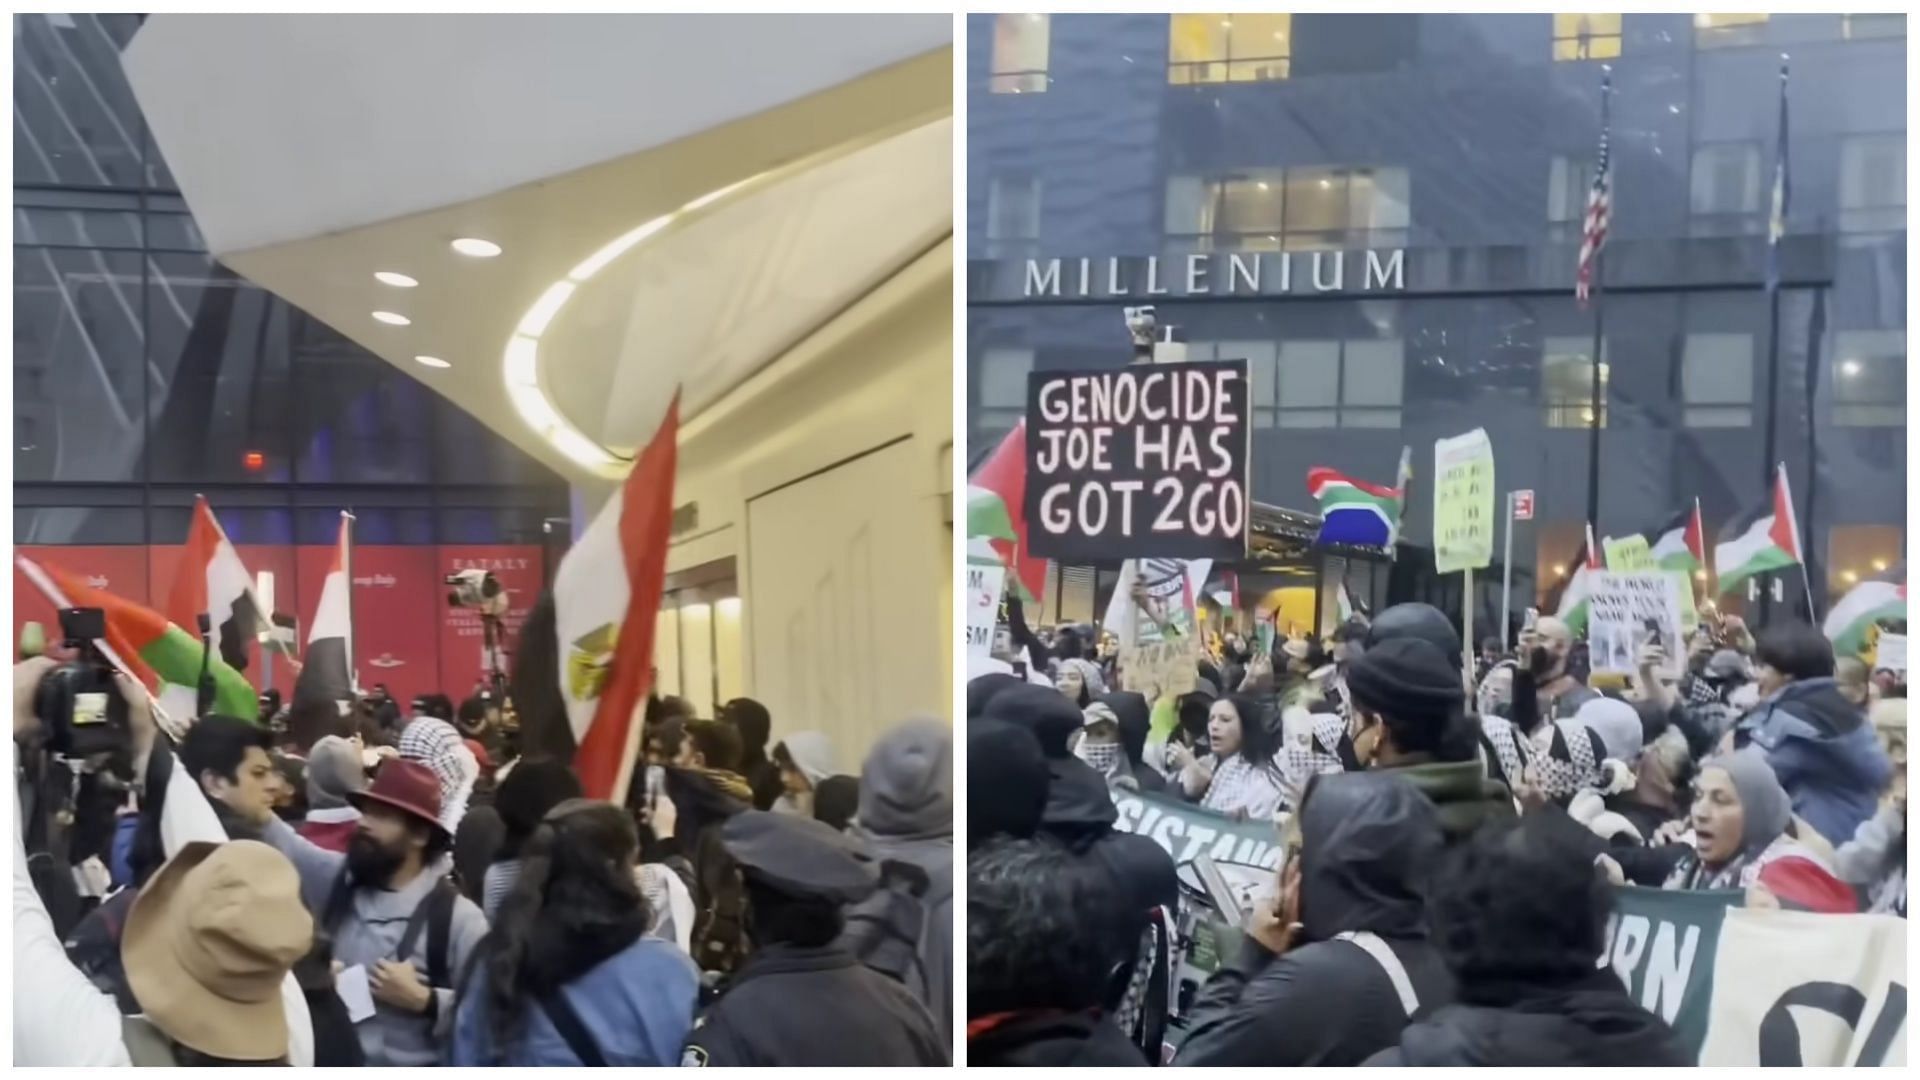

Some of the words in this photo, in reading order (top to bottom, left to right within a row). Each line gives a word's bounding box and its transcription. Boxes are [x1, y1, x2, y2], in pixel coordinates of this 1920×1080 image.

[1024, 250, 1404, 295] MILLENIUM
[1038, 370, 1239, 425] GENOCIDE
[1036, 429, 1113, 474] JOE
[1135, 424, 1234, 478] HAS
[453, 558, 529, 570] EATALY
